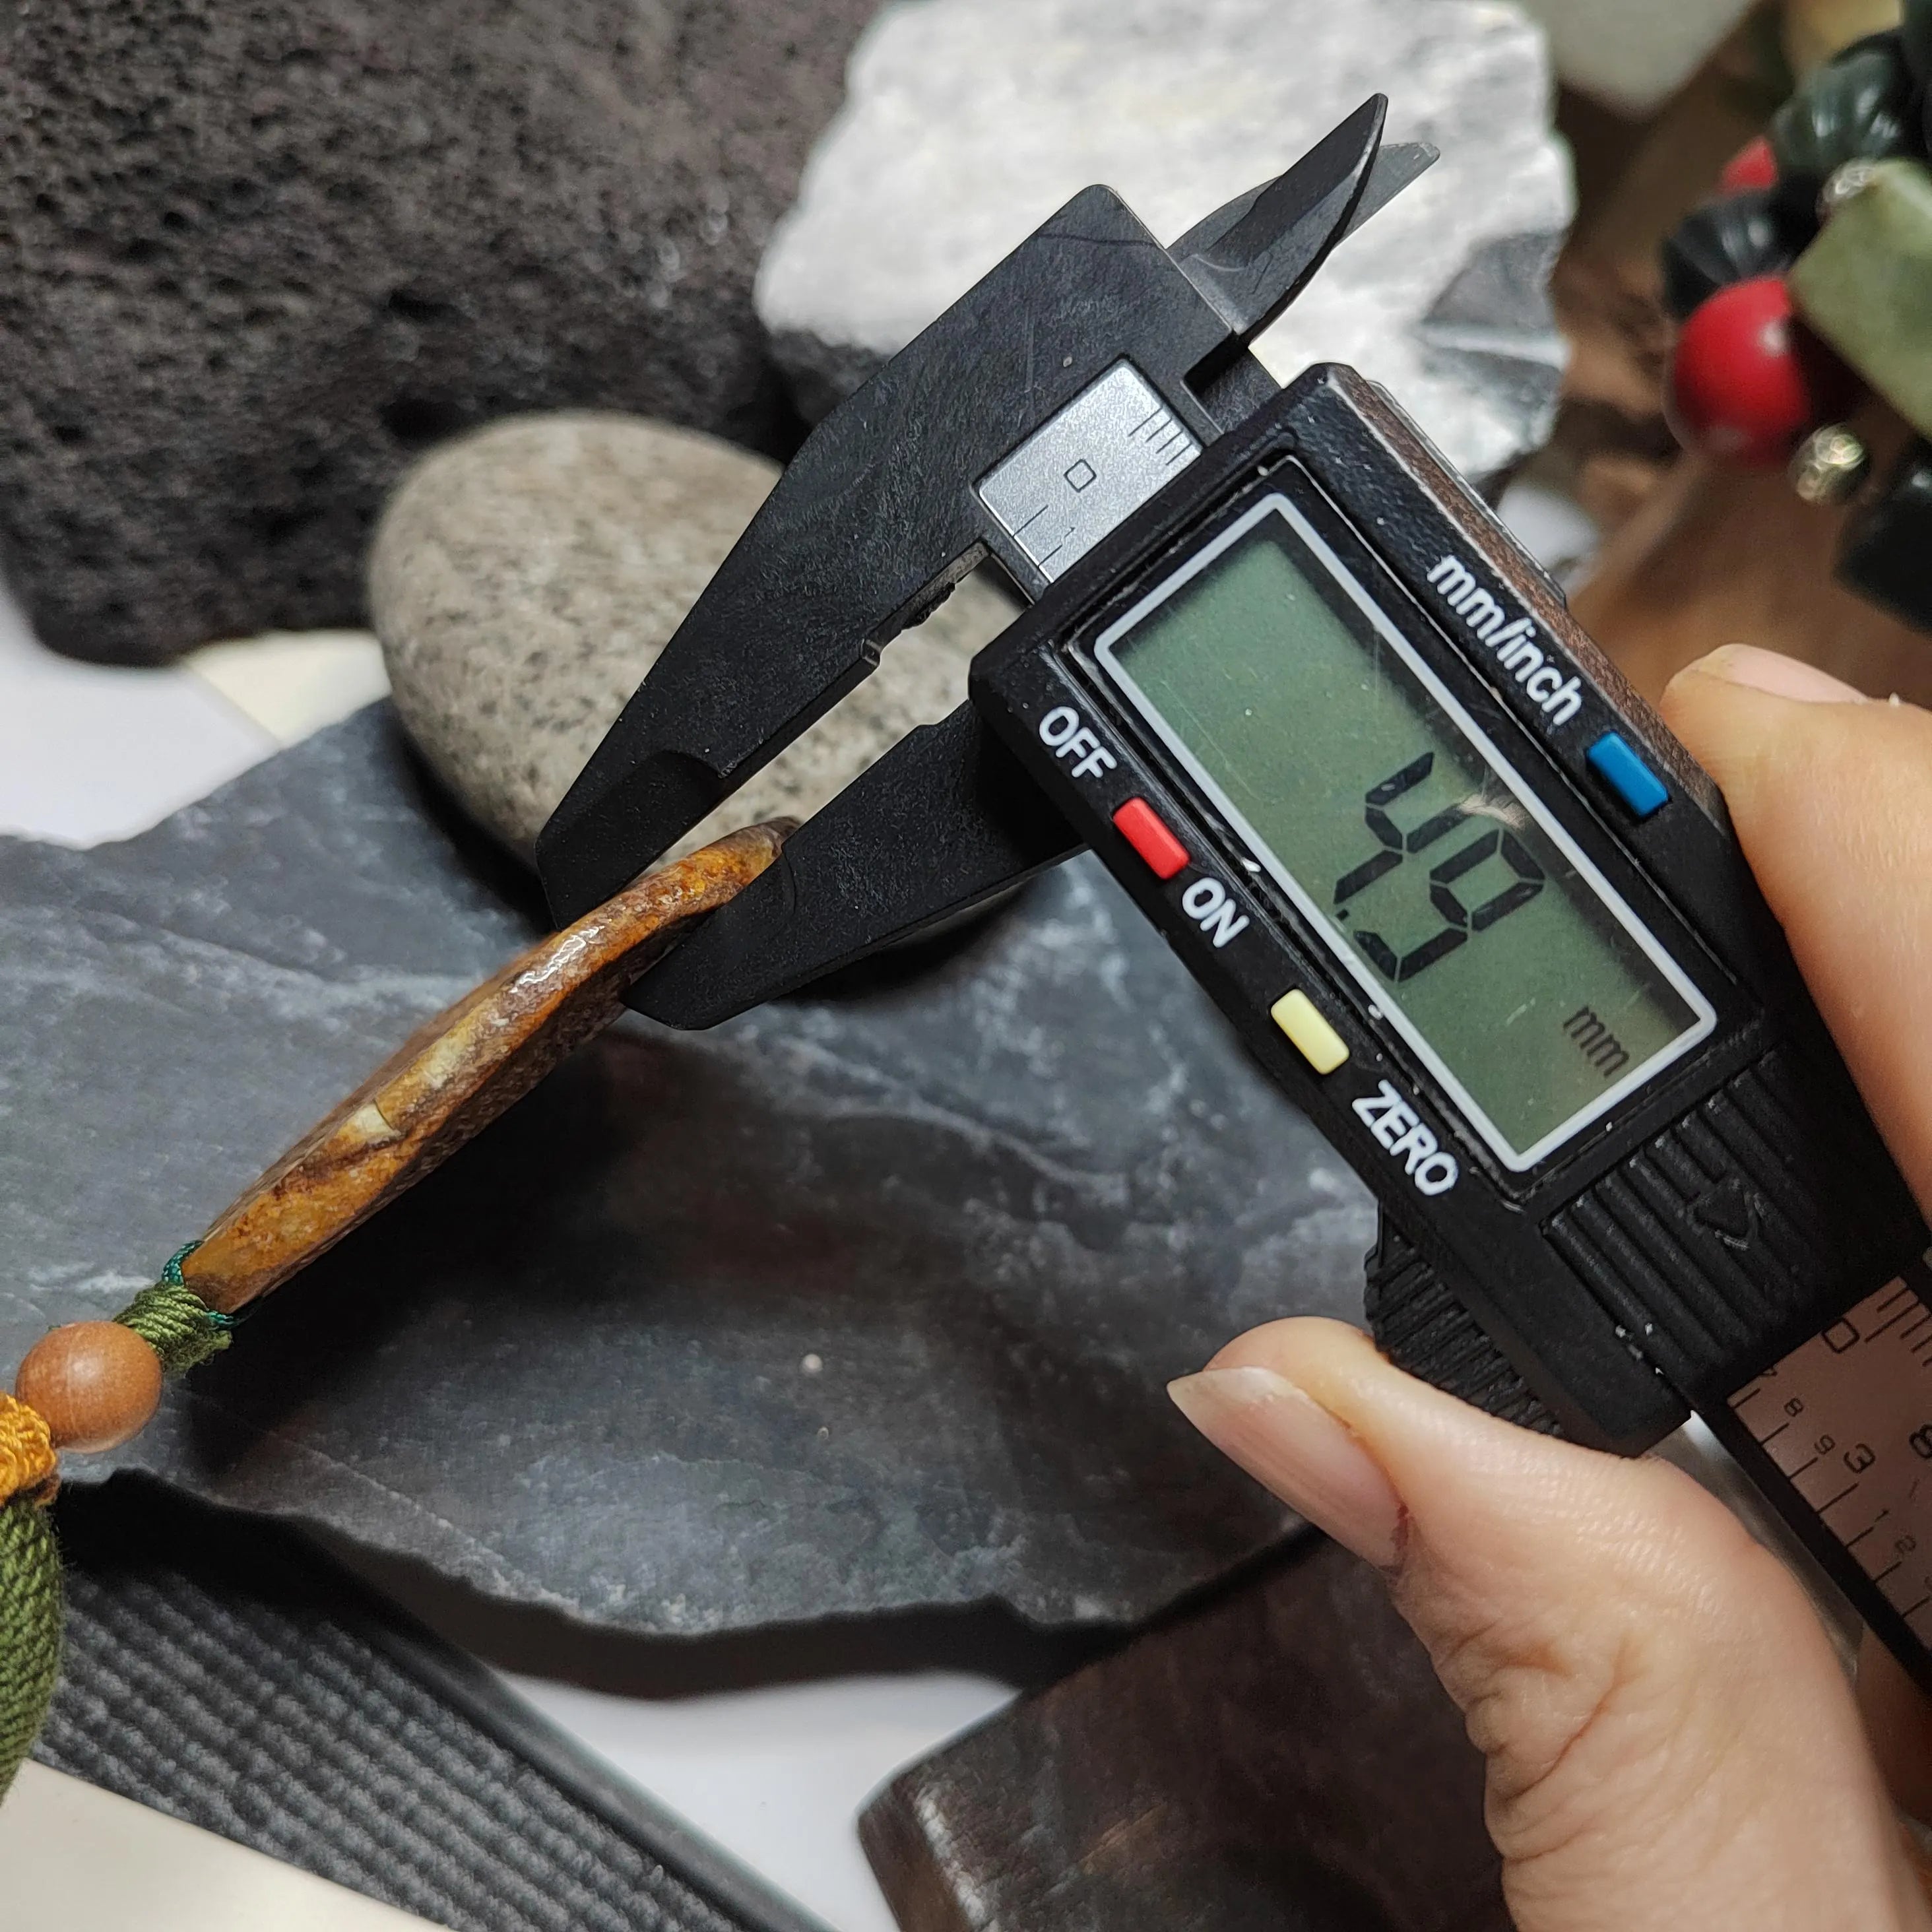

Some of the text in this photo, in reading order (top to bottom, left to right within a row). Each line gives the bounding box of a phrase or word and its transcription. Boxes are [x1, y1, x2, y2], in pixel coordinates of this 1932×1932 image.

[1427, 554, 1583, 726] mm/inch
[1038, 706, 1118, 779] OFF
[1181, 877, 1250, 948] ON
[1562, 1005, 1630, 1078] mm
[1351, 1078, 1459, 1196] ZERO
[1784, 1397, 1804, 1417] 8
[1843, 1443, 1876, 1473] 3
